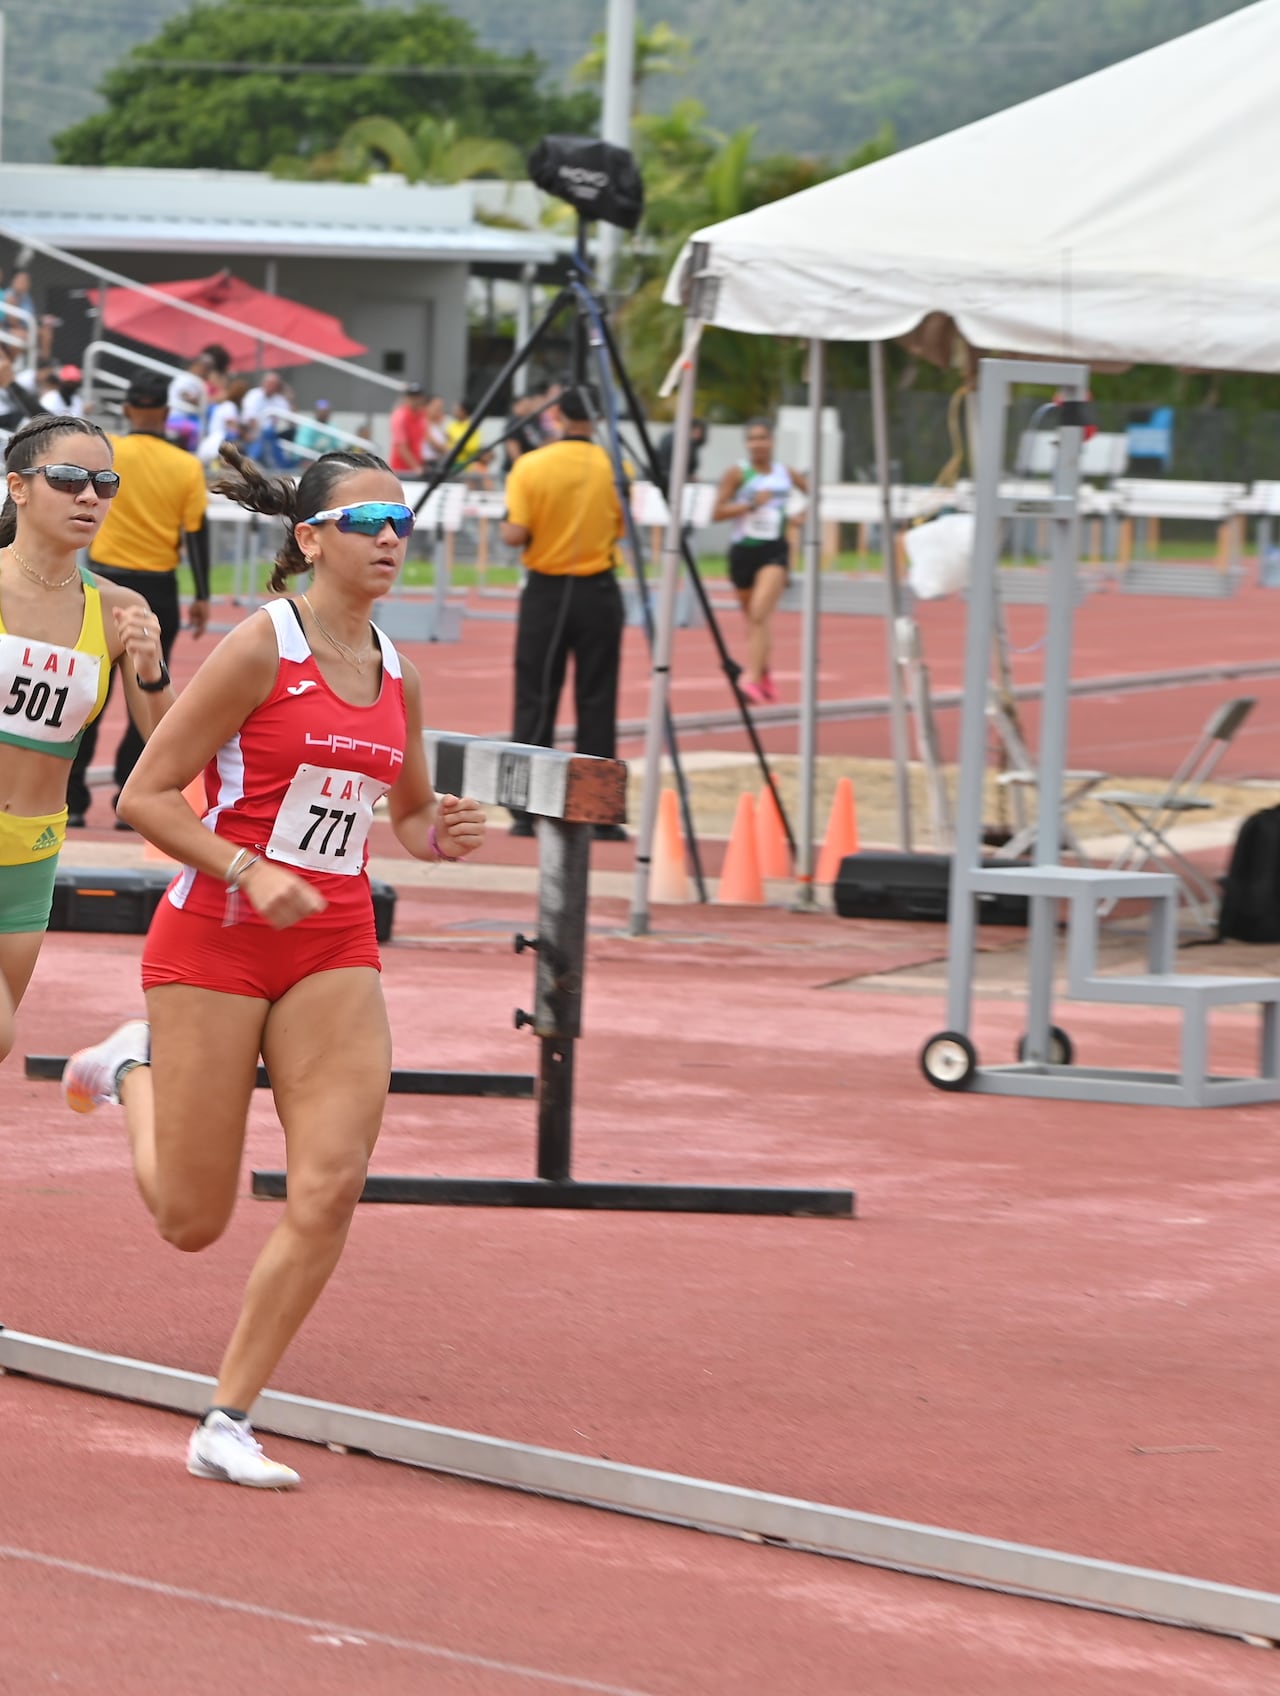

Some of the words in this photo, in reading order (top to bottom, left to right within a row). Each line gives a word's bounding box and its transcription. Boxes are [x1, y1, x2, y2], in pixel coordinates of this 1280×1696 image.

[22, 647, 76, 677] LAI
[2, 675, 70, 728] 501
[298, 804, 357, 857] 771
